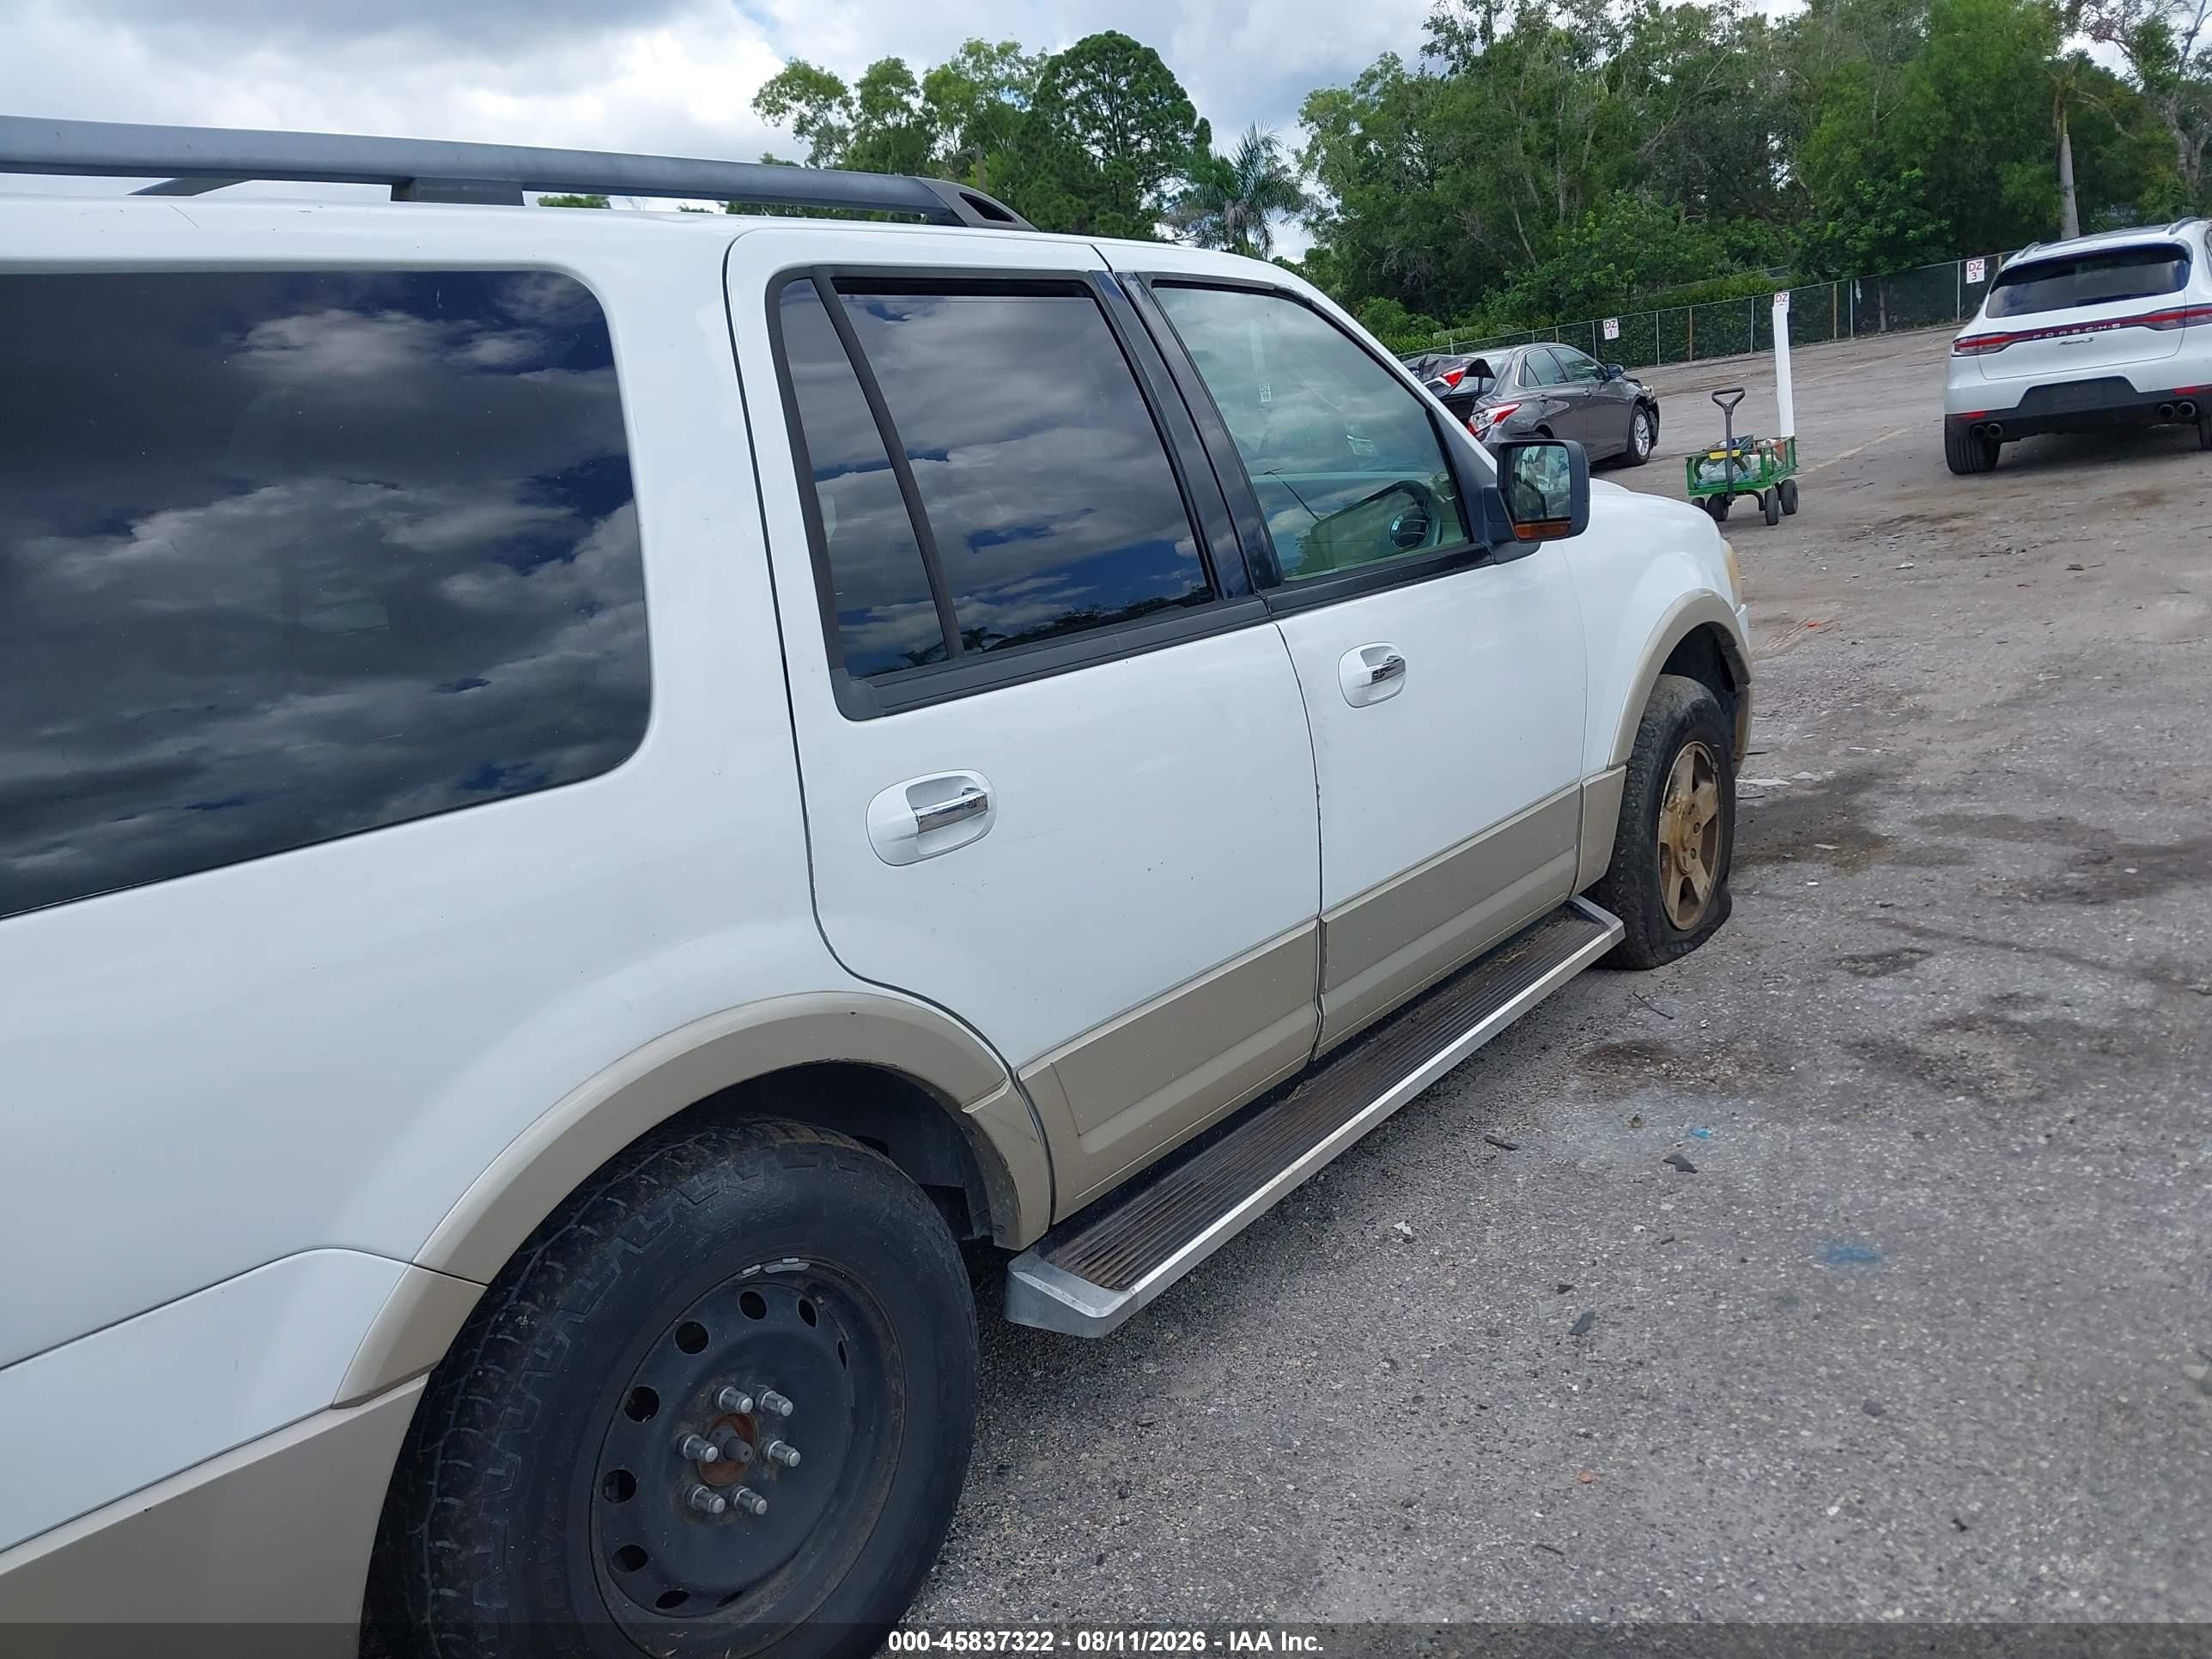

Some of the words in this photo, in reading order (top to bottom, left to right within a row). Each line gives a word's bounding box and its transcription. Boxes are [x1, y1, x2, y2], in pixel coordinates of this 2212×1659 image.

[1968, 260, 1983, 271] DZ
[1971, 271, 1978, 281] 3
[1776, 293, 1788, 302] DZ
[1604, 319, 1617, 329] DZ
[2033, 323, 2121, 339] PORSCHE
